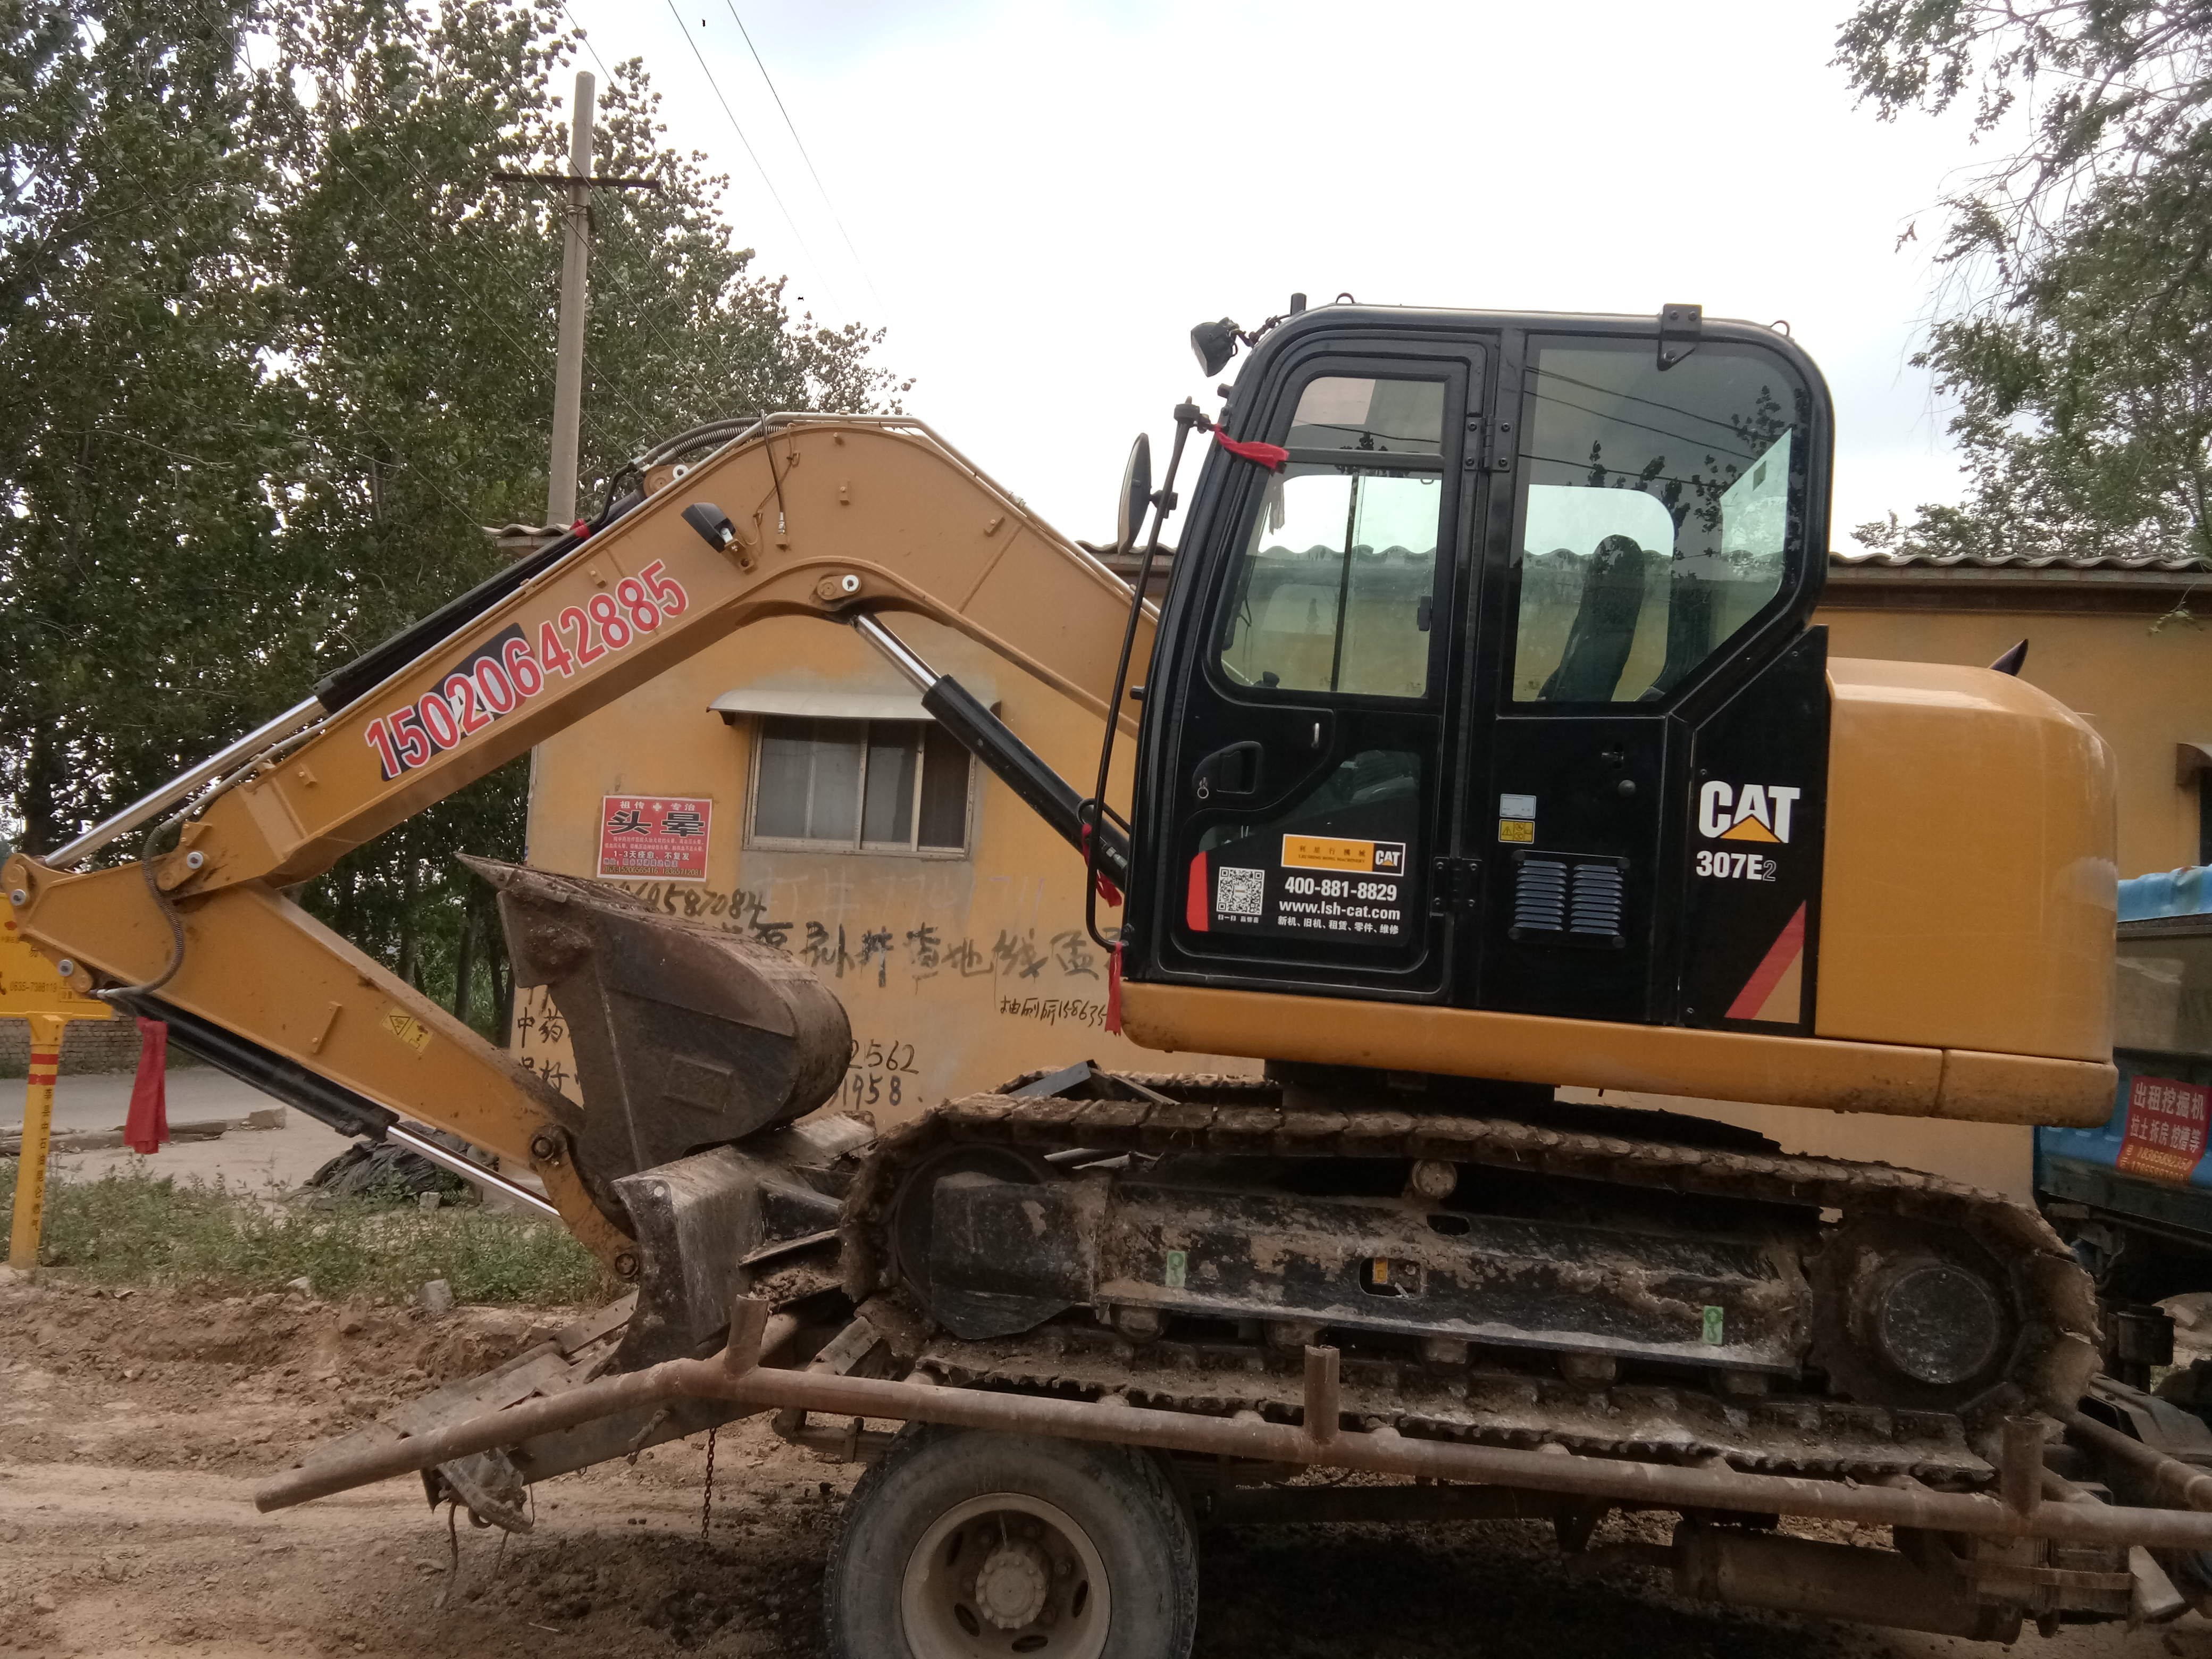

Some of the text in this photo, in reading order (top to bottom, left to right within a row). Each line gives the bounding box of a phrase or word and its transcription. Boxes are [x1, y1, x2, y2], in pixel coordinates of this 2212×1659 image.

[364, 558, 689, 779] 15020642885
[619, 800, 696, 811] 祖传 专治
[1698, 780, 1801, 844] CAT
[607, 810, 705, 837] 头晕
[1375, 850, 1401, 867] CAT
[1696, 850, 1777, 882] 307E2
[1284, 876, 1398, 901] 400-881-8829
[1278, 901, 1401, 920] www.lsh-cat.com
[517, 1006, 565, 1049] 中药
